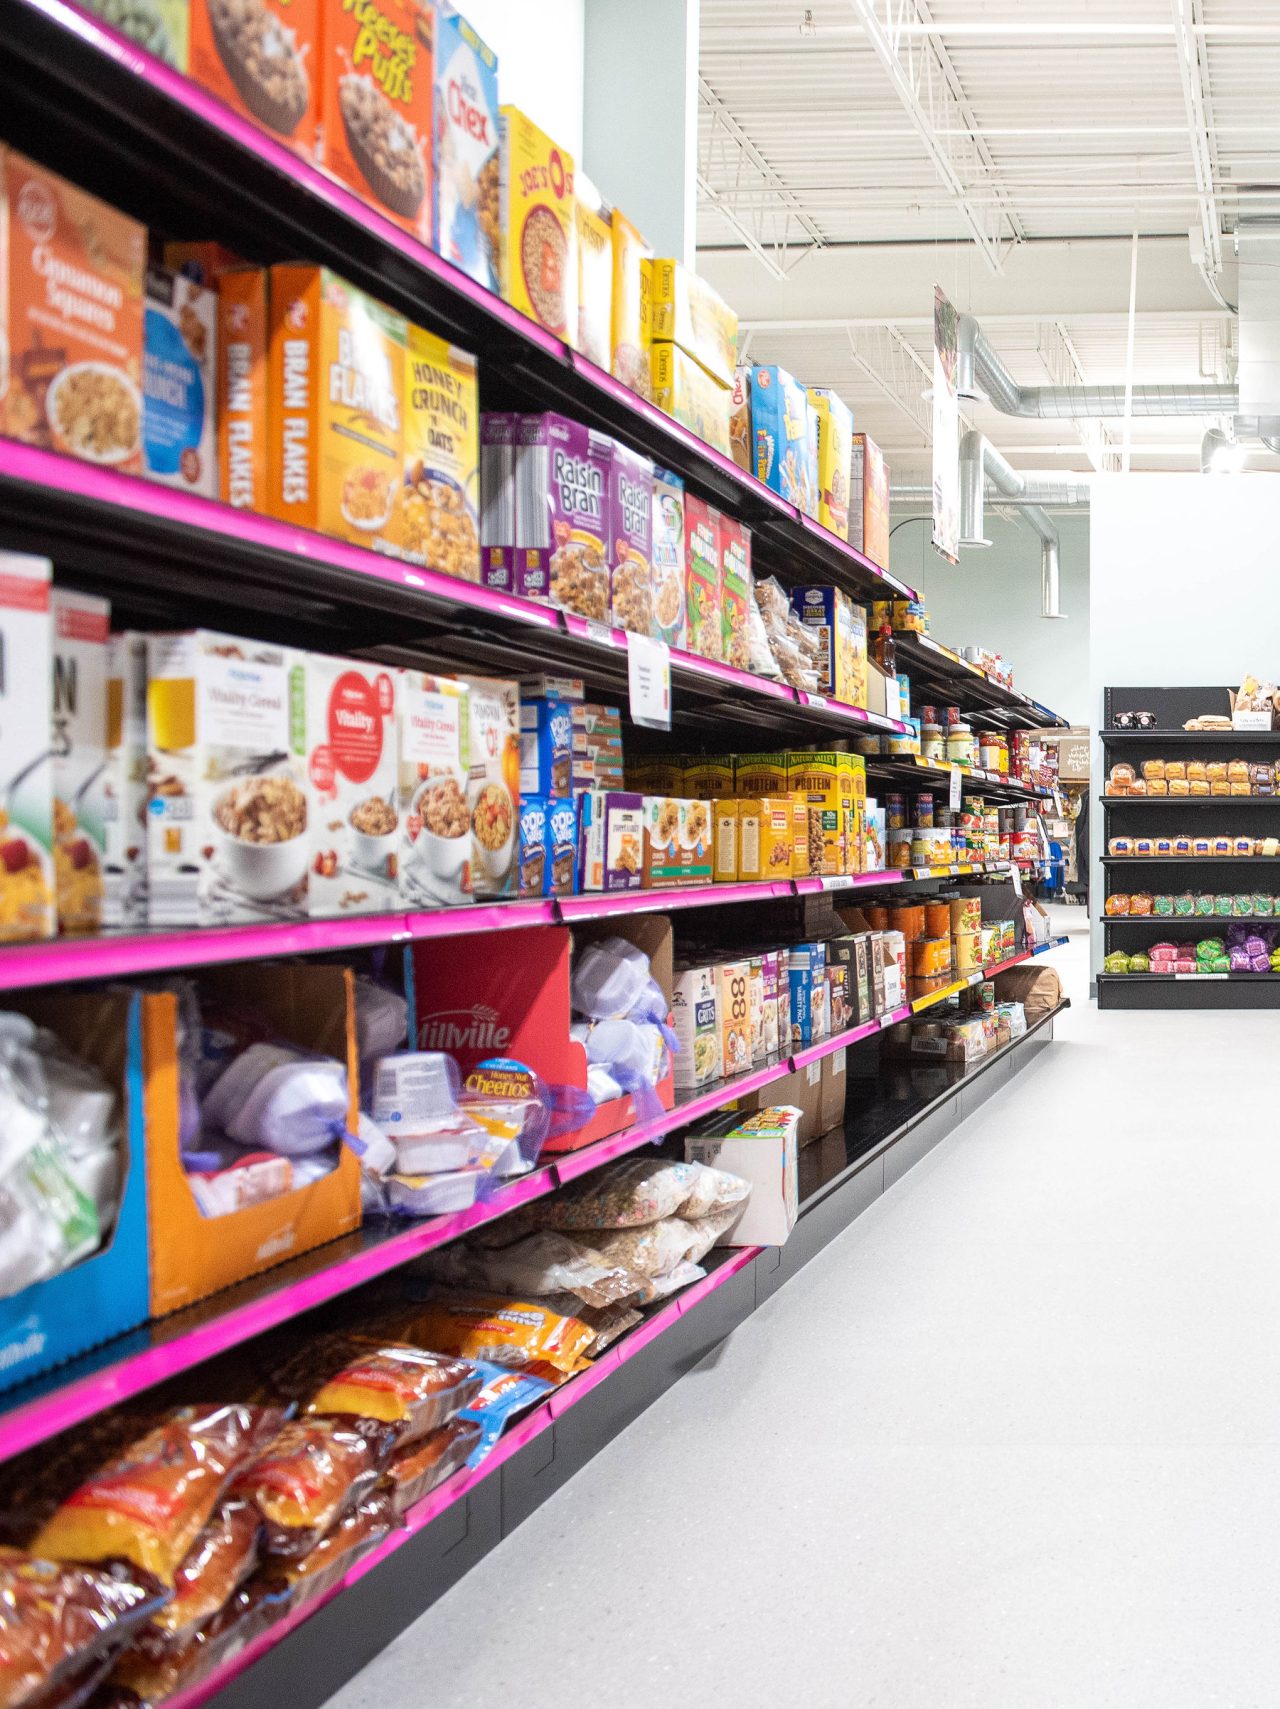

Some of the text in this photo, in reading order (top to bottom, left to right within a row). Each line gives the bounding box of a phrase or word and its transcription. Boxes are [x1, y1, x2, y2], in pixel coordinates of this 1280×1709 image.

[448, 79, 489, 146] Chex
[412, 362, 464, 397] HONEY
[227, 343, 254, 508] BRAN FLAKES
[283, 340, 309, 504] BRAN FLAKES
[412, 389, 467, 432] CRUNCH
[428, 428, 454, 453] OATS
[554, 451, 601, 495] Raisin
[561, 483, 600, 514] Bran
[619, 474, 649, 509] Raisin
[623, 508, 648, 534] Bran
[335, 708, 374, 734] Vitality
[814, 755, 836, 765] VALLEY
[743, 779, 778, 791] PROTEIN
[795, 778, 831, 790] PROTEIN
[465, 1073, 531, 1099] Cheerios
